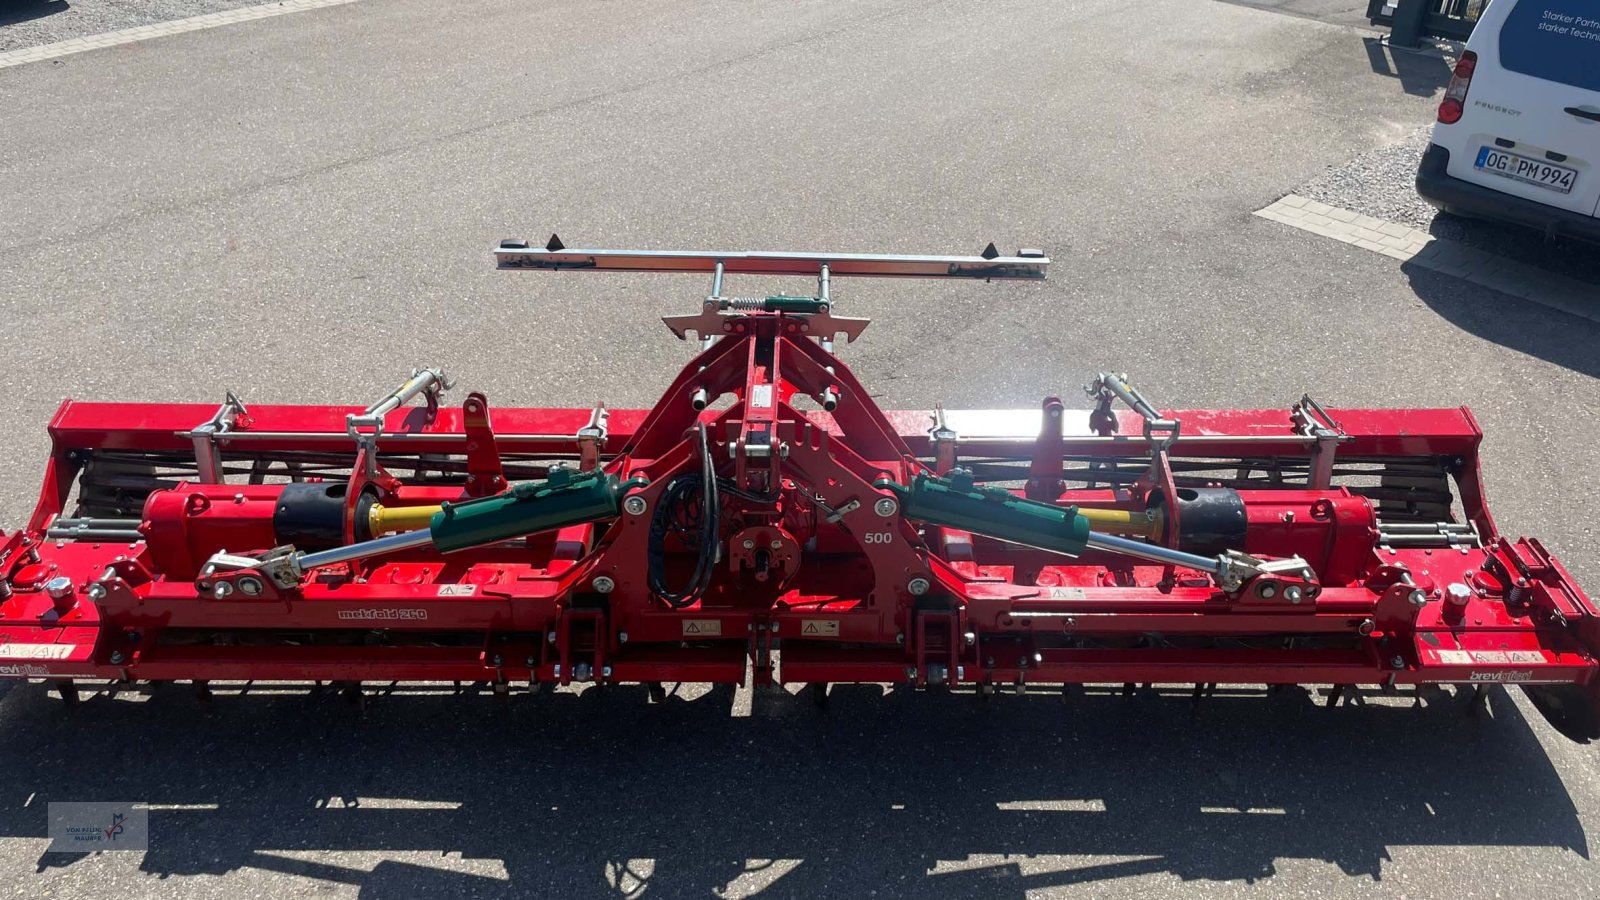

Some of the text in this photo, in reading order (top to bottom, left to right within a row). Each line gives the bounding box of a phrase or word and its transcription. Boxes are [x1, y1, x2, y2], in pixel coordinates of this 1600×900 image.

[1542, 10, 1574, 24] Starker
[1537, 21, 1569, 35] starker
[1474, 100, 1522, 117] PEUGEOT
[1486, 153, 1508, 170] OG
[864, 532, 892, 544] 500
[338, 608, 399, 619] mekfold
